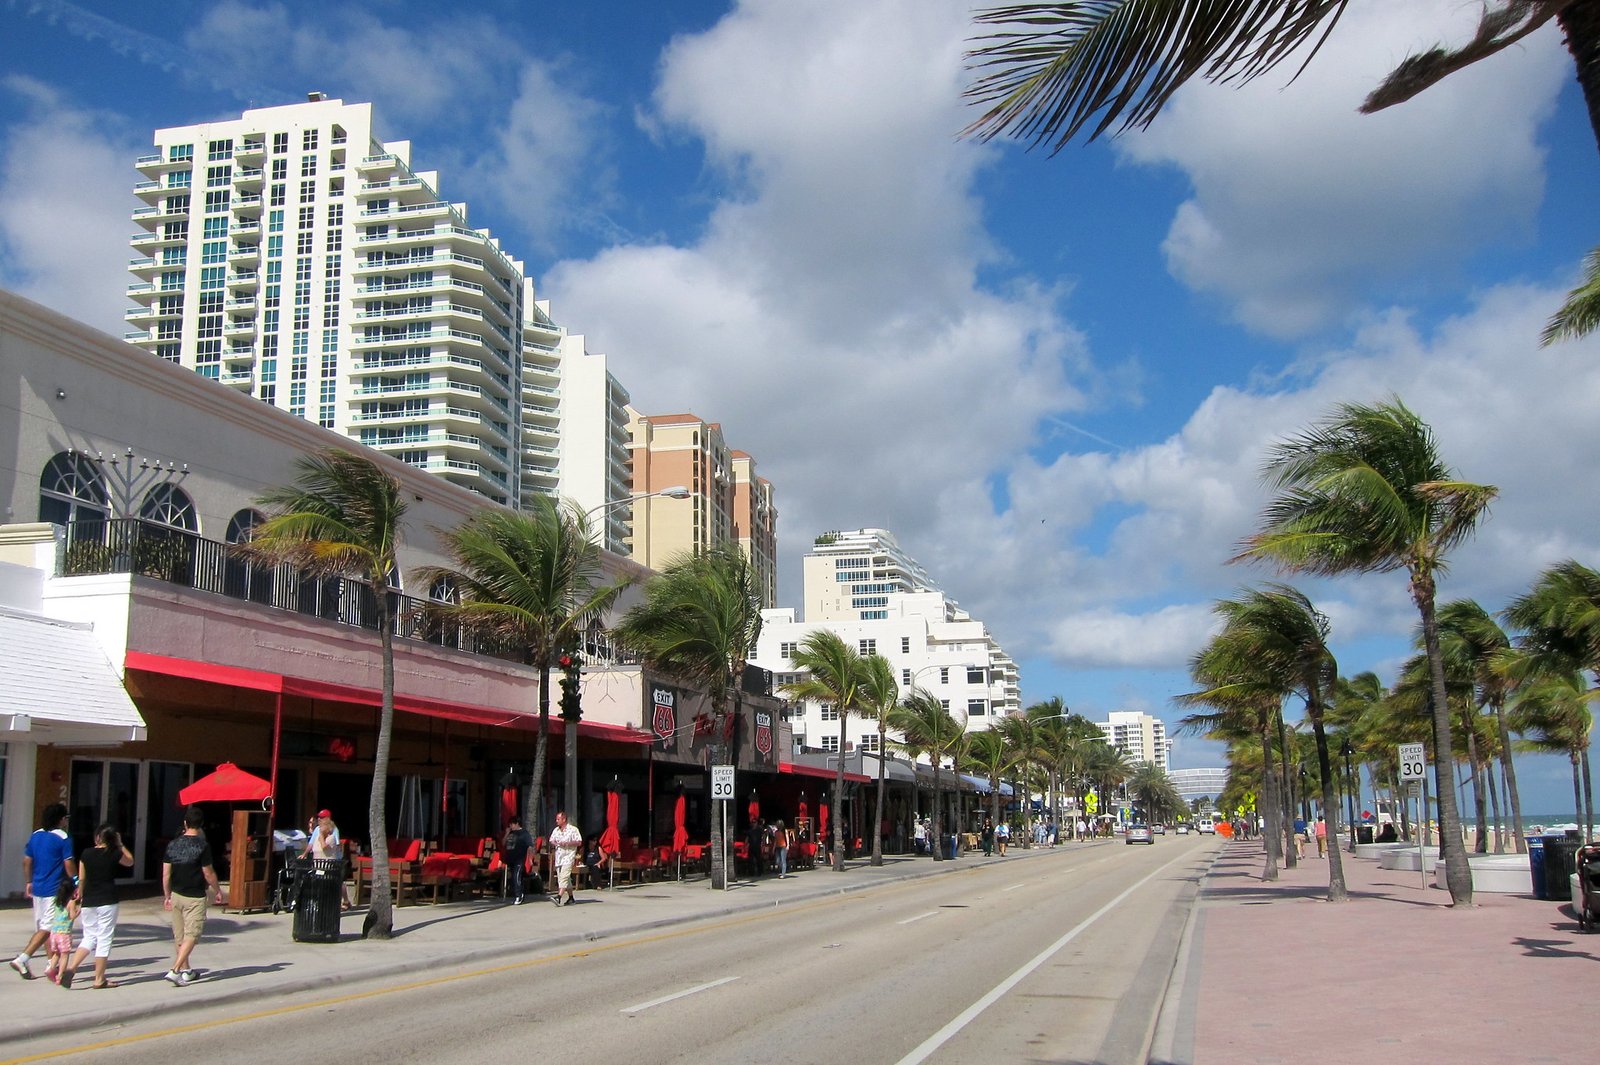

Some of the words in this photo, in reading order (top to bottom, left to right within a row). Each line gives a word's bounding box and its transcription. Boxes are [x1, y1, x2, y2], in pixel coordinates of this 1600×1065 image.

[656, 693, 670, 703] EXIT
[657, 707, 671, 732] 66
[758, 716, 768, 724] EXIT
[1403, 762, 1423, 776] 30
[714, 783, 732, 795] 30
